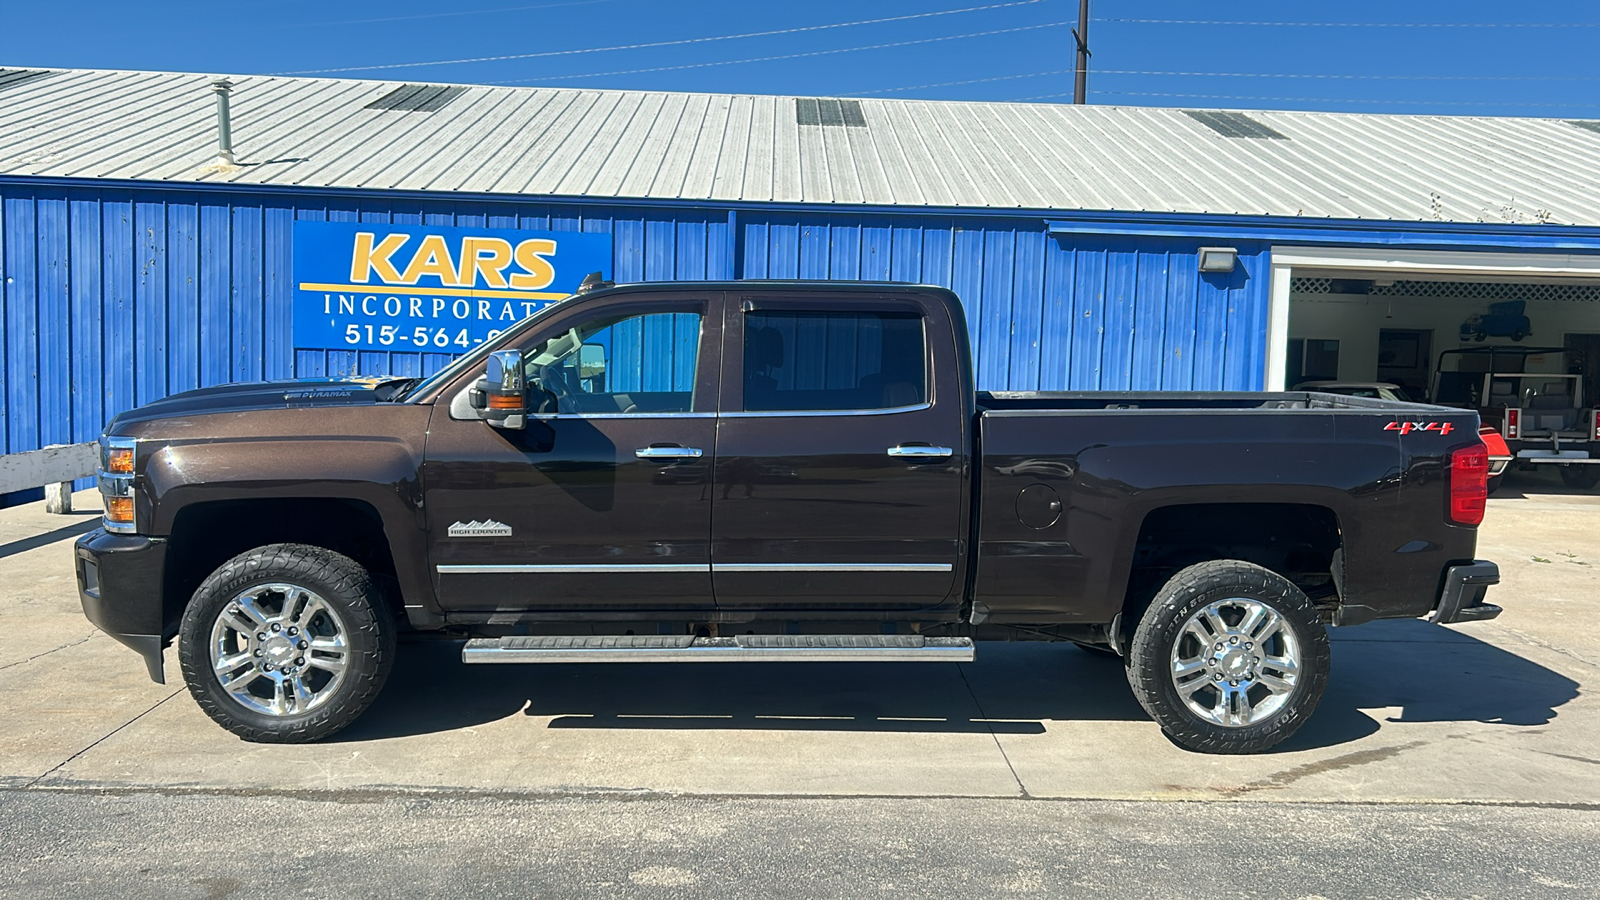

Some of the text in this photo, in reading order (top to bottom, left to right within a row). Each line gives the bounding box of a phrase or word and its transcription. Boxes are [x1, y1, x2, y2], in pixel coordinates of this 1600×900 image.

[349, 231, 557, 290] KARS
[323, 294, 552, 321] INCORPORAT
[302, 390, 352, 398] DURAMAX
